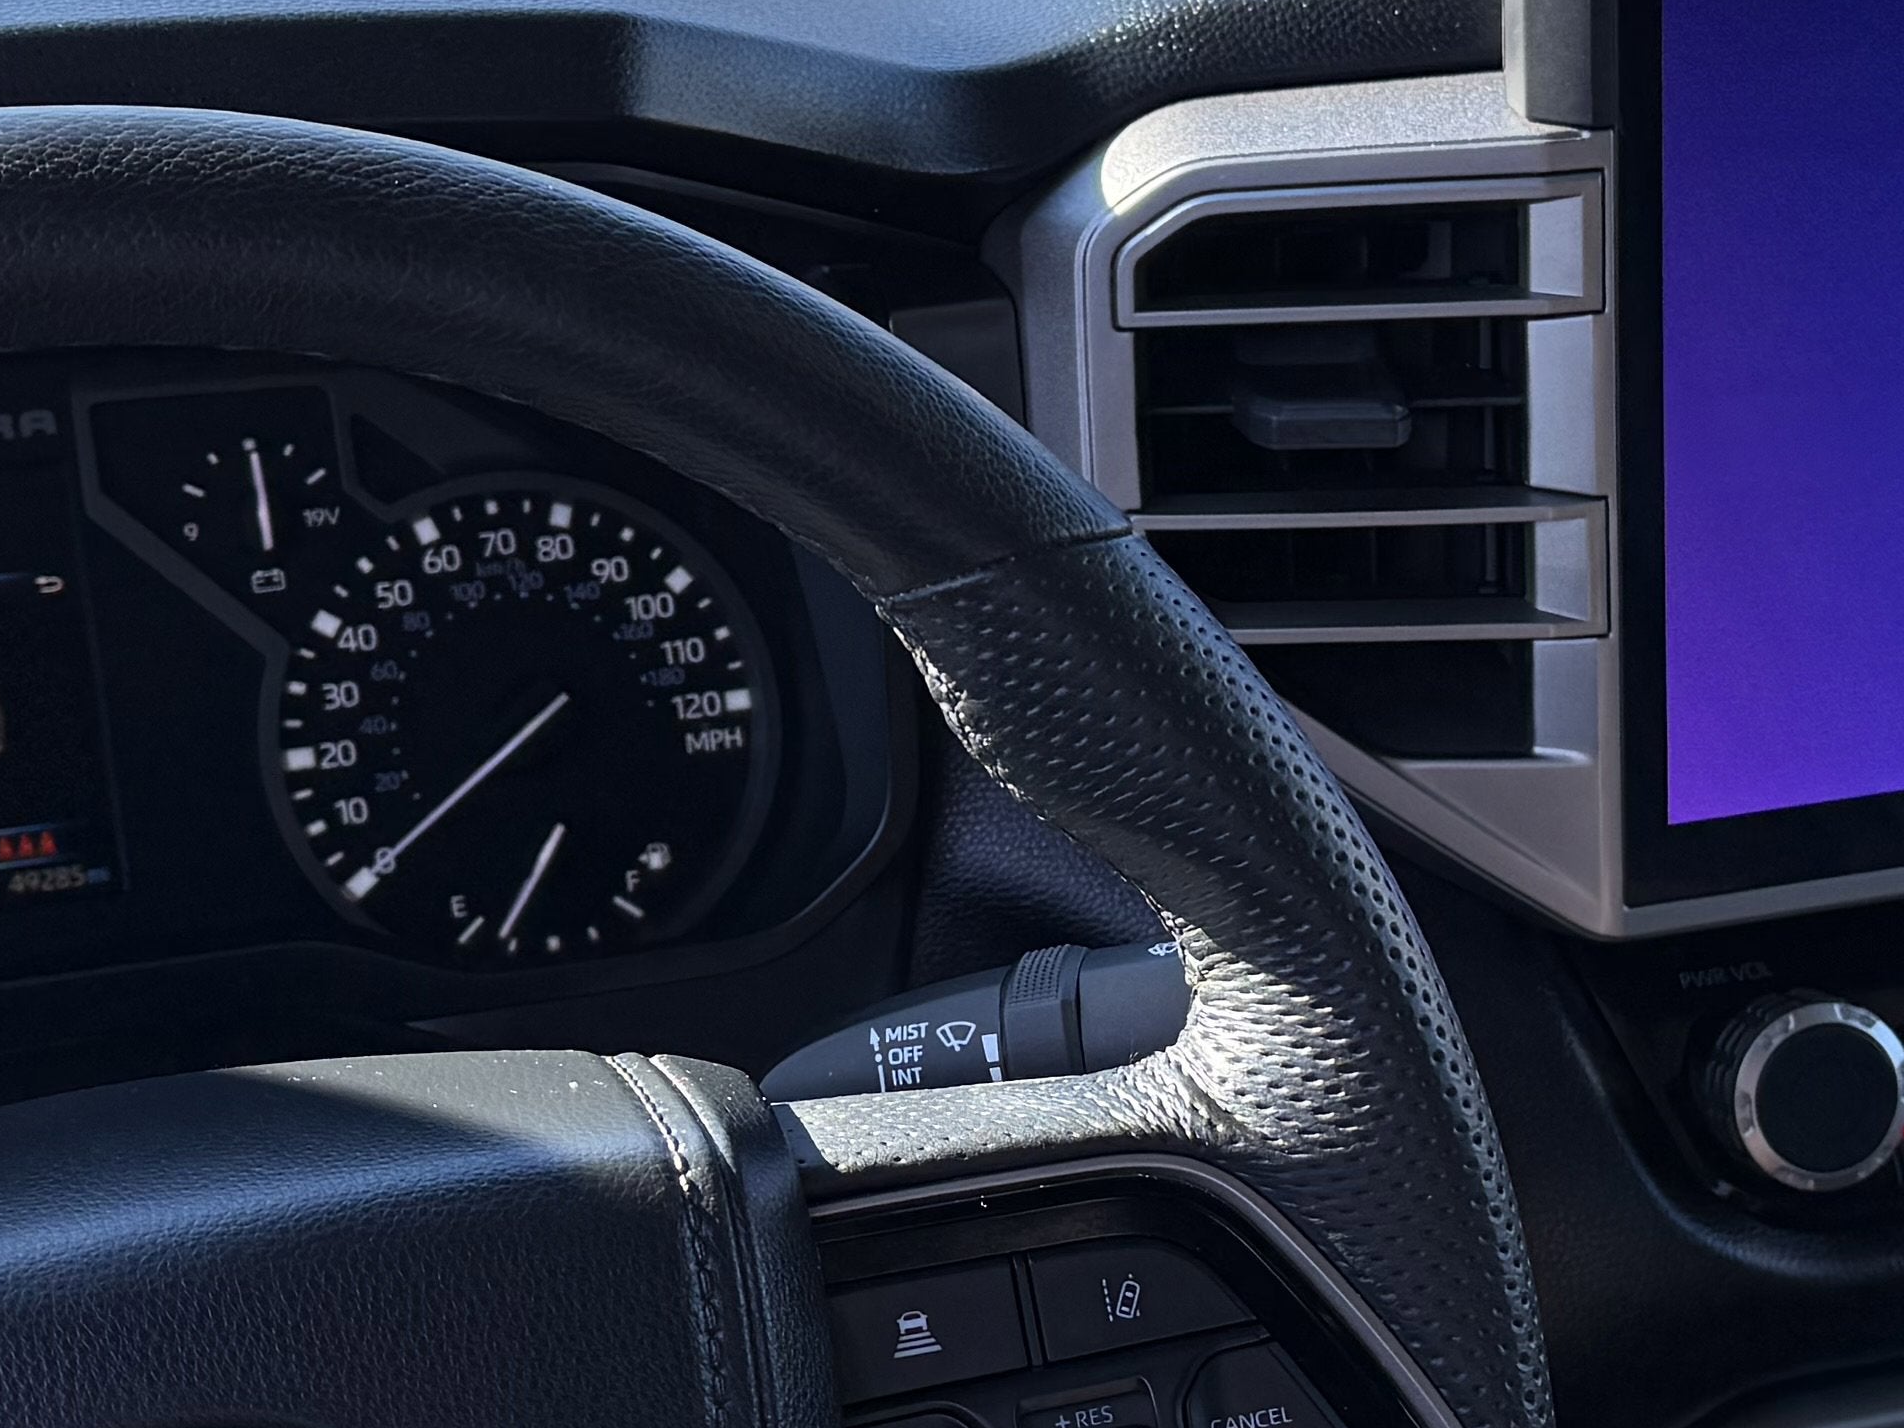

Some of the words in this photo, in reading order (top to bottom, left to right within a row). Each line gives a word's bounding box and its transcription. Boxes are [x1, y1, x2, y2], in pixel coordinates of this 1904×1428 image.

[303, 507, 341, 528] 19V
[478, 530, 517, 558] 70
[536, 534, 574, 562] 80
[422, 545, 461, 574] 60
[591, 556, 629, 584] 90
[374, 579, 413, 609] 50
[450, 580, 486, 603] 100
[564, 581, 601, 603] 140
[625, 591, 675, 621] 100
[337, 623, 378, 653] 40
[661, 637, 705, 664] 110
[321, 680, 360, 710] 30
[672, 692, 722, 720] 120
[358, 713, 389, 736] 40
[319, 739, 357, 769] 20
[685, 728, 744, 754] MPH
[333, 796, 369, 825] 10
[8, 865, 86, 894] 49285
[626, 869, 641, 892] F
[449, 895, 467, 919] E
[885, 1022, 929, 1043] MIST
[888, 1045, 923, 1065] OFF
[891, 1066, 922, 1086] INT
